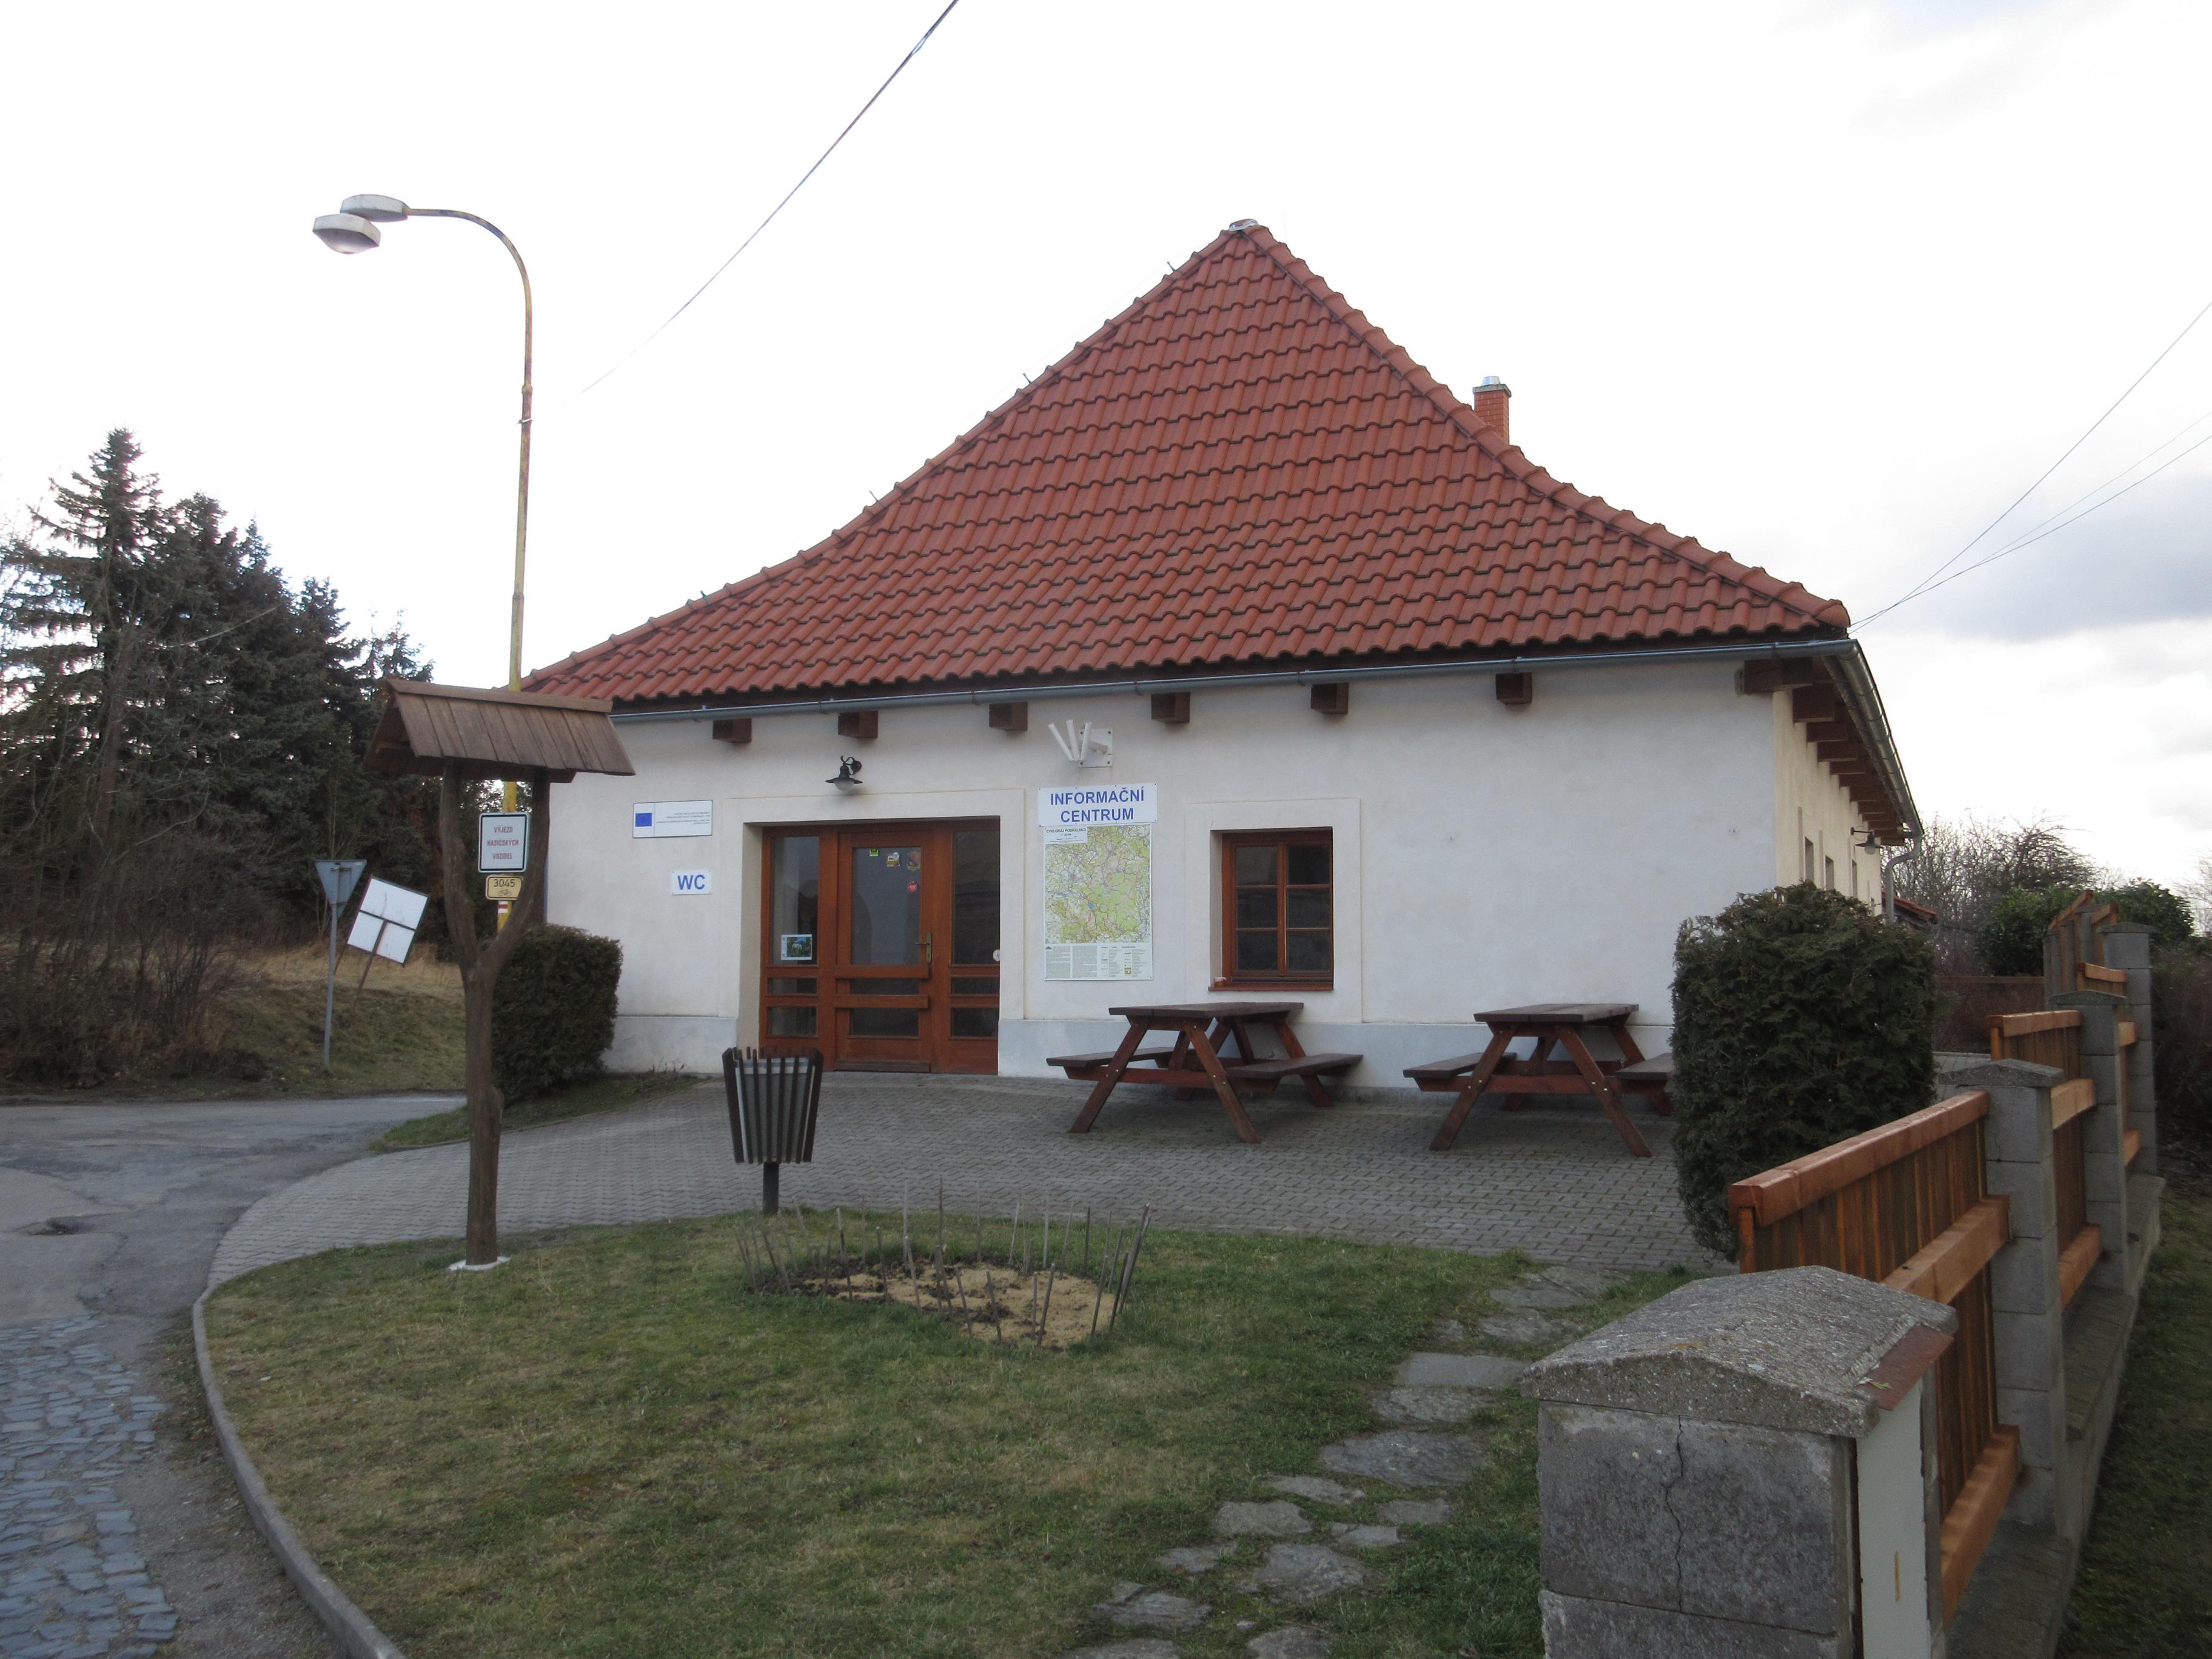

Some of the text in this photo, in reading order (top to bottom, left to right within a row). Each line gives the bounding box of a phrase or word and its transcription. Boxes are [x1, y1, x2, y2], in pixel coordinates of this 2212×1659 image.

[1050, 786, 1145, 805] INFORMAČNÍ
[1061, 808, 1134, 823] CENTRUM
[487, 838, 519, 846] HASIČSKÝCH
[494, 879, 515, 888] 3045
[677, 874, 705, 890] WC
